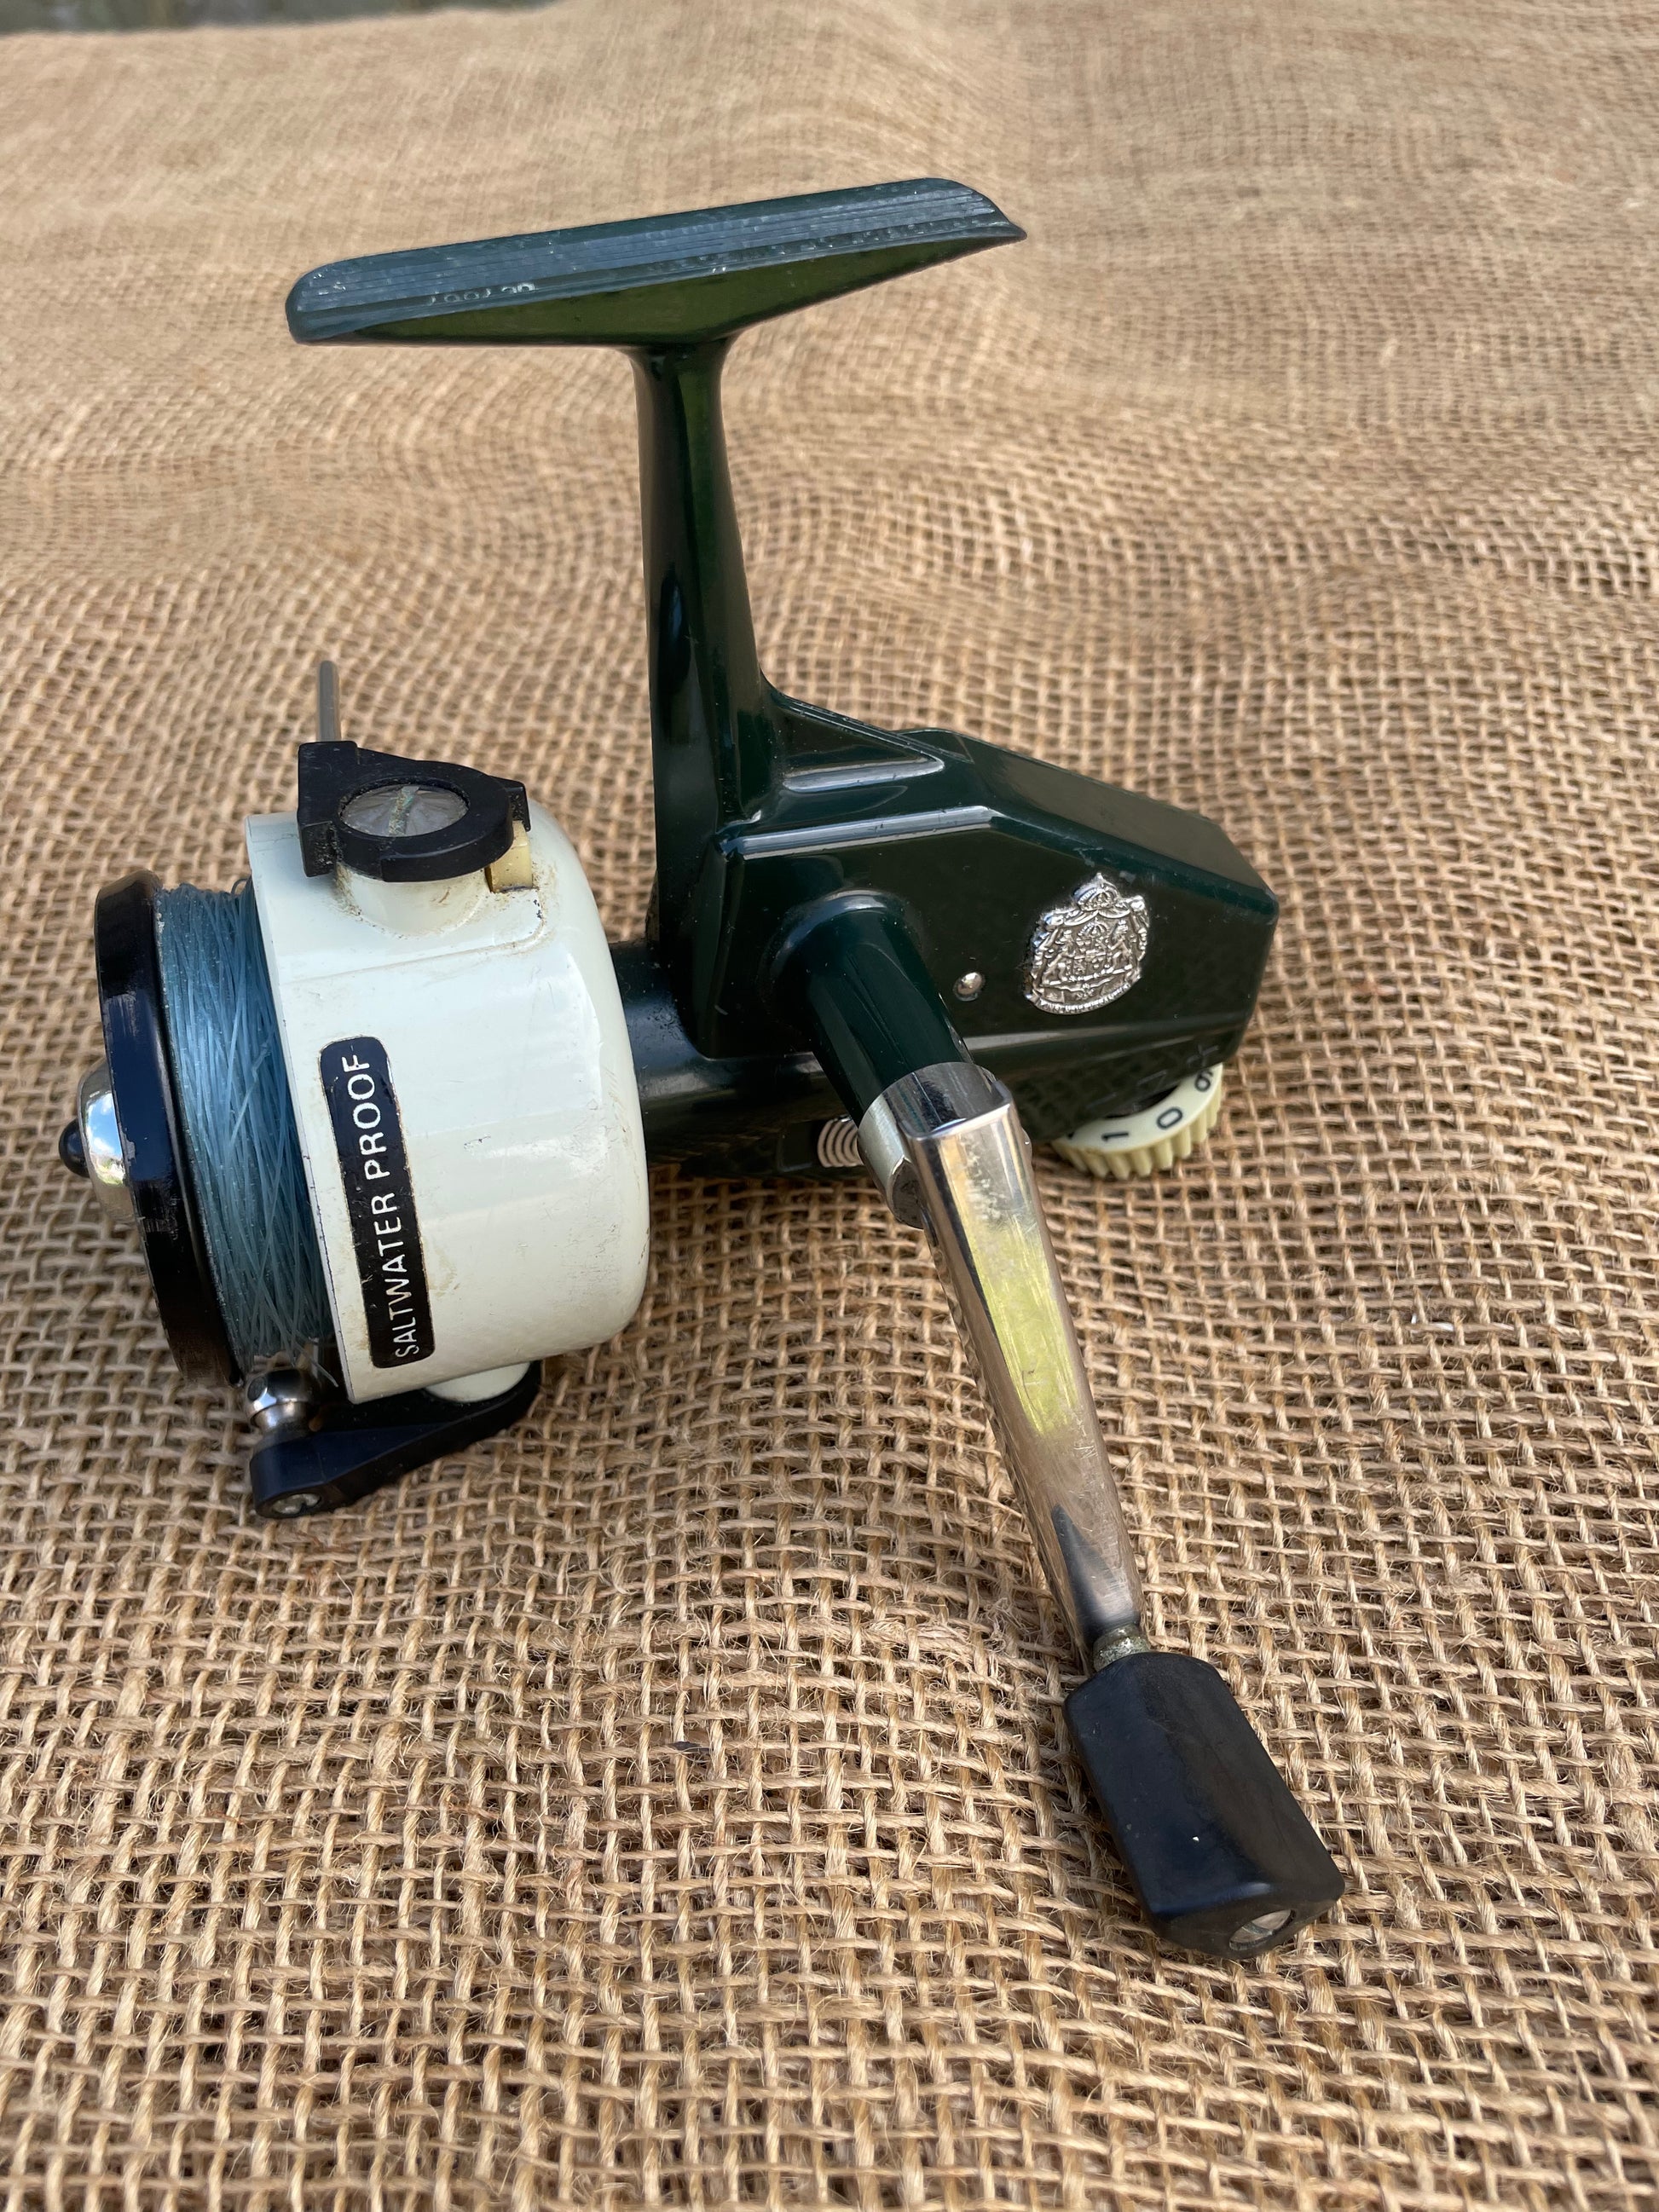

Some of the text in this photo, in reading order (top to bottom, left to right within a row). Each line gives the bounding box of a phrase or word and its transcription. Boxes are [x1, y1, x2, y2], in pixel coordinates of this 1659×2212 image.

[342, 1054, 419, 1359] SALTWATER PROOF
[1101, 1130, 1130, 1142] 1
